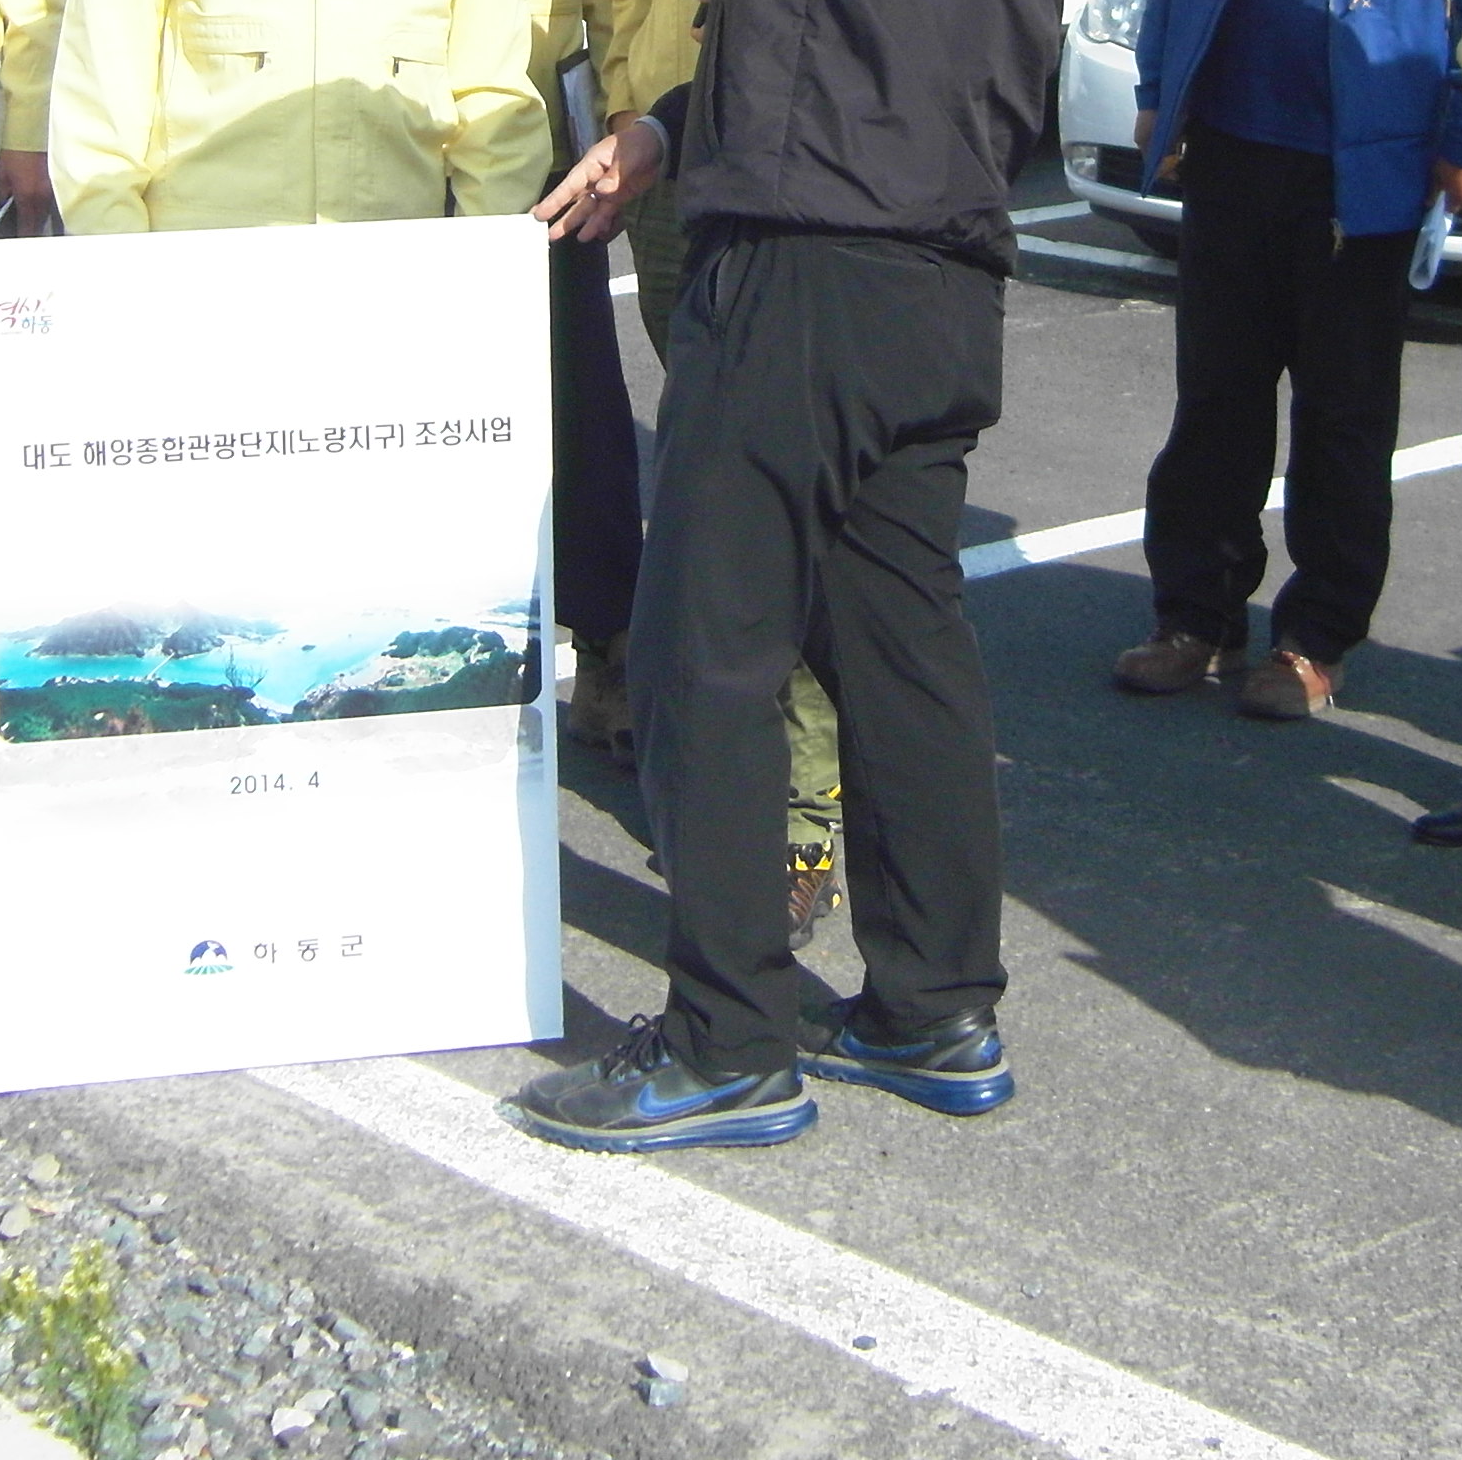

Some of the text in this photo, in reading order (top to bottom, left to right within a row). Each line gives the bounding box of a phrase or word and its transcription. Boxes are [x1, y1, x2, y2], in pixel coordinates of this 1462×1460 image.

[23, 416, 512, 470] 대도 해양종합관광단지(노량지구) 조성사업
[230, 770, 320, 795] 2014. 4
